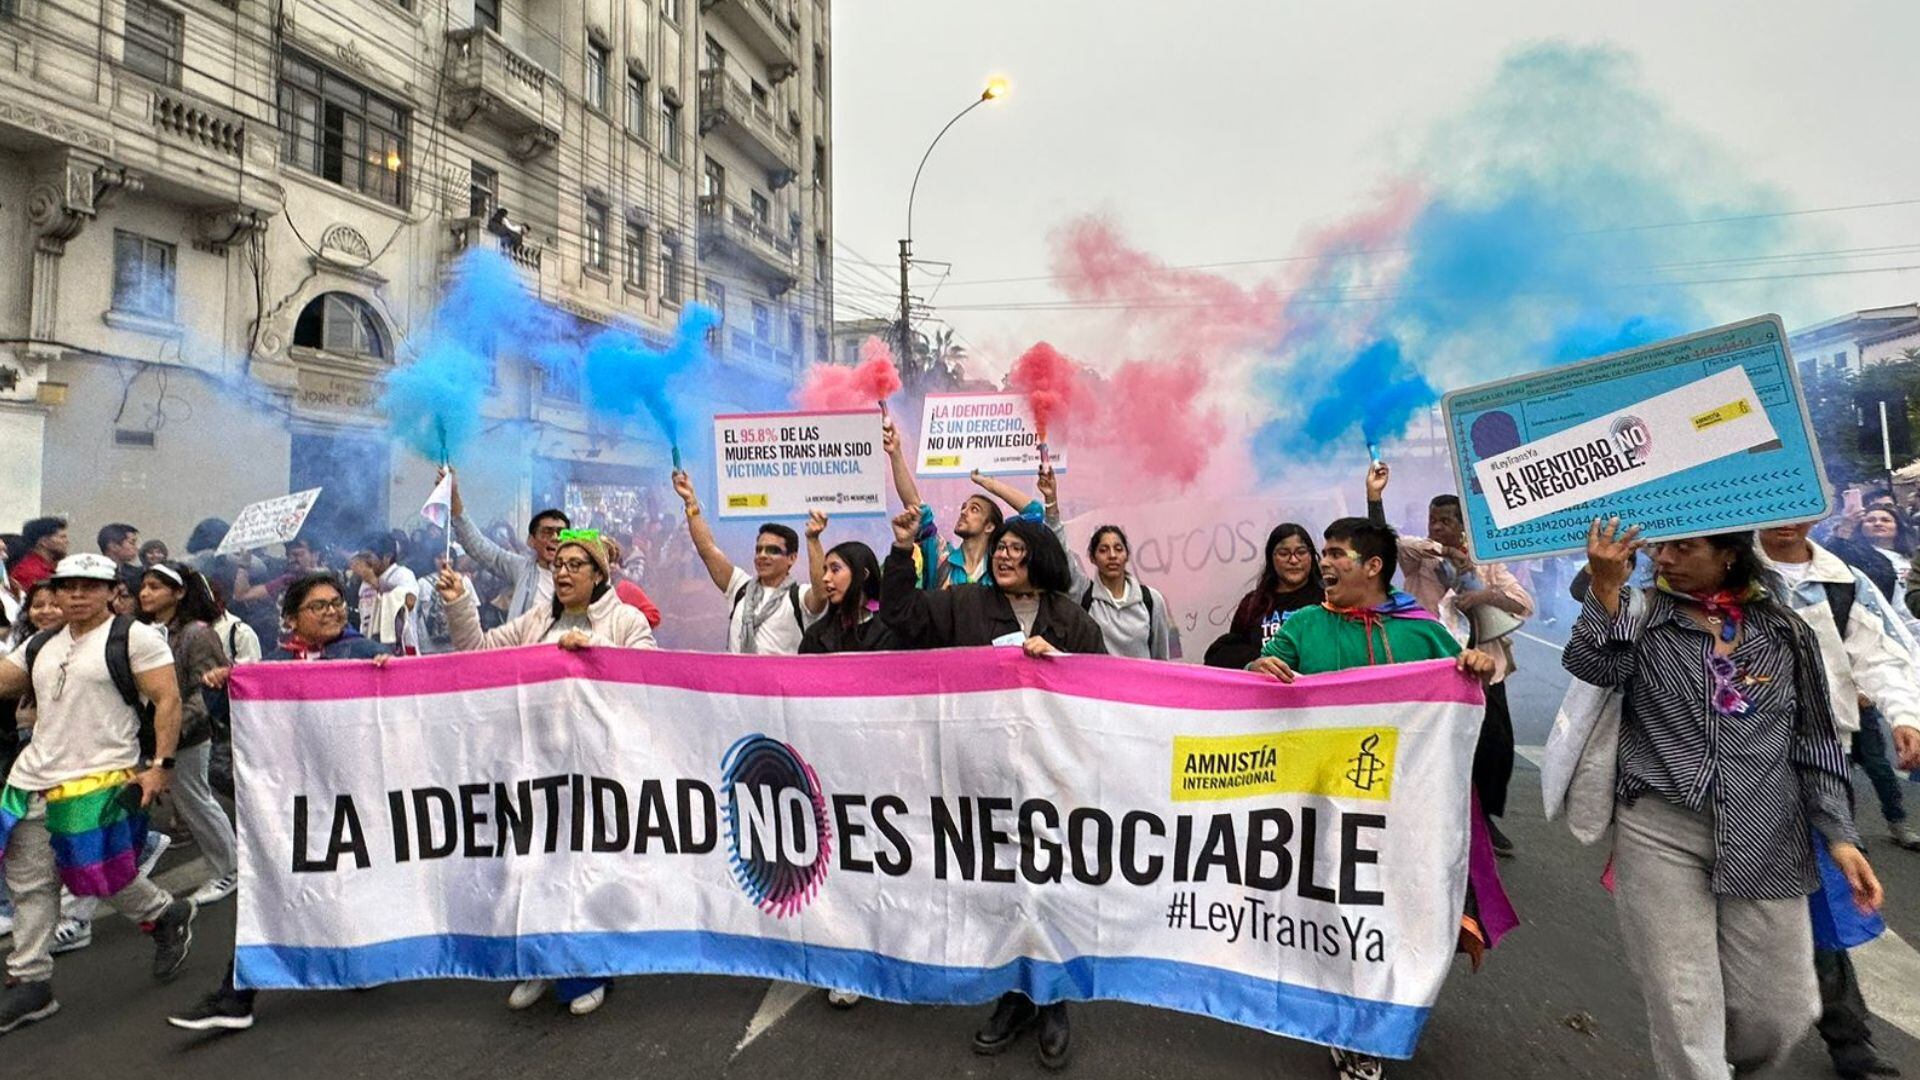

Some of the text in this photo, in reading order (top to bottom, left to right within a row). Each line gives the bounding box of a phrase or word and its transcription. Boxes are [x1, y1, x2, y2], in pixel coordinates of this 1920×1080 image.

[931, 403, 1013, 421] ¡LA IDENTIDAD
[724, 426, 819, 443] EL 95.8% DE LAS
[929, 417, 1026, 435] ES UN DERECHO,
[725, 442, 872, 461] MUJERES TRANS HAN SIDO
[927, 434, 1038, 450] NO UN PRIVILEGIO!
[725, 459, 863, 478] VÍCTIMAS DE VIOLENCIA.
[1490, 448, 1538, 471] #LeyTransYa
[1496, 426, 1648, 495] LA IDENTIDAD NO
[1502, 449, 1646, 510] ES NEGOCIABLE.
[1184, 744, 1277, 774] AMNISTÍA
[1183, 770, 1277, 790] INTERNACIONAL
[292, 774, 1387, 906] LA IDENTIDAD NO ES NEGOCIABLE
[1166, 892, 1386, 964] #LeyTransYa
